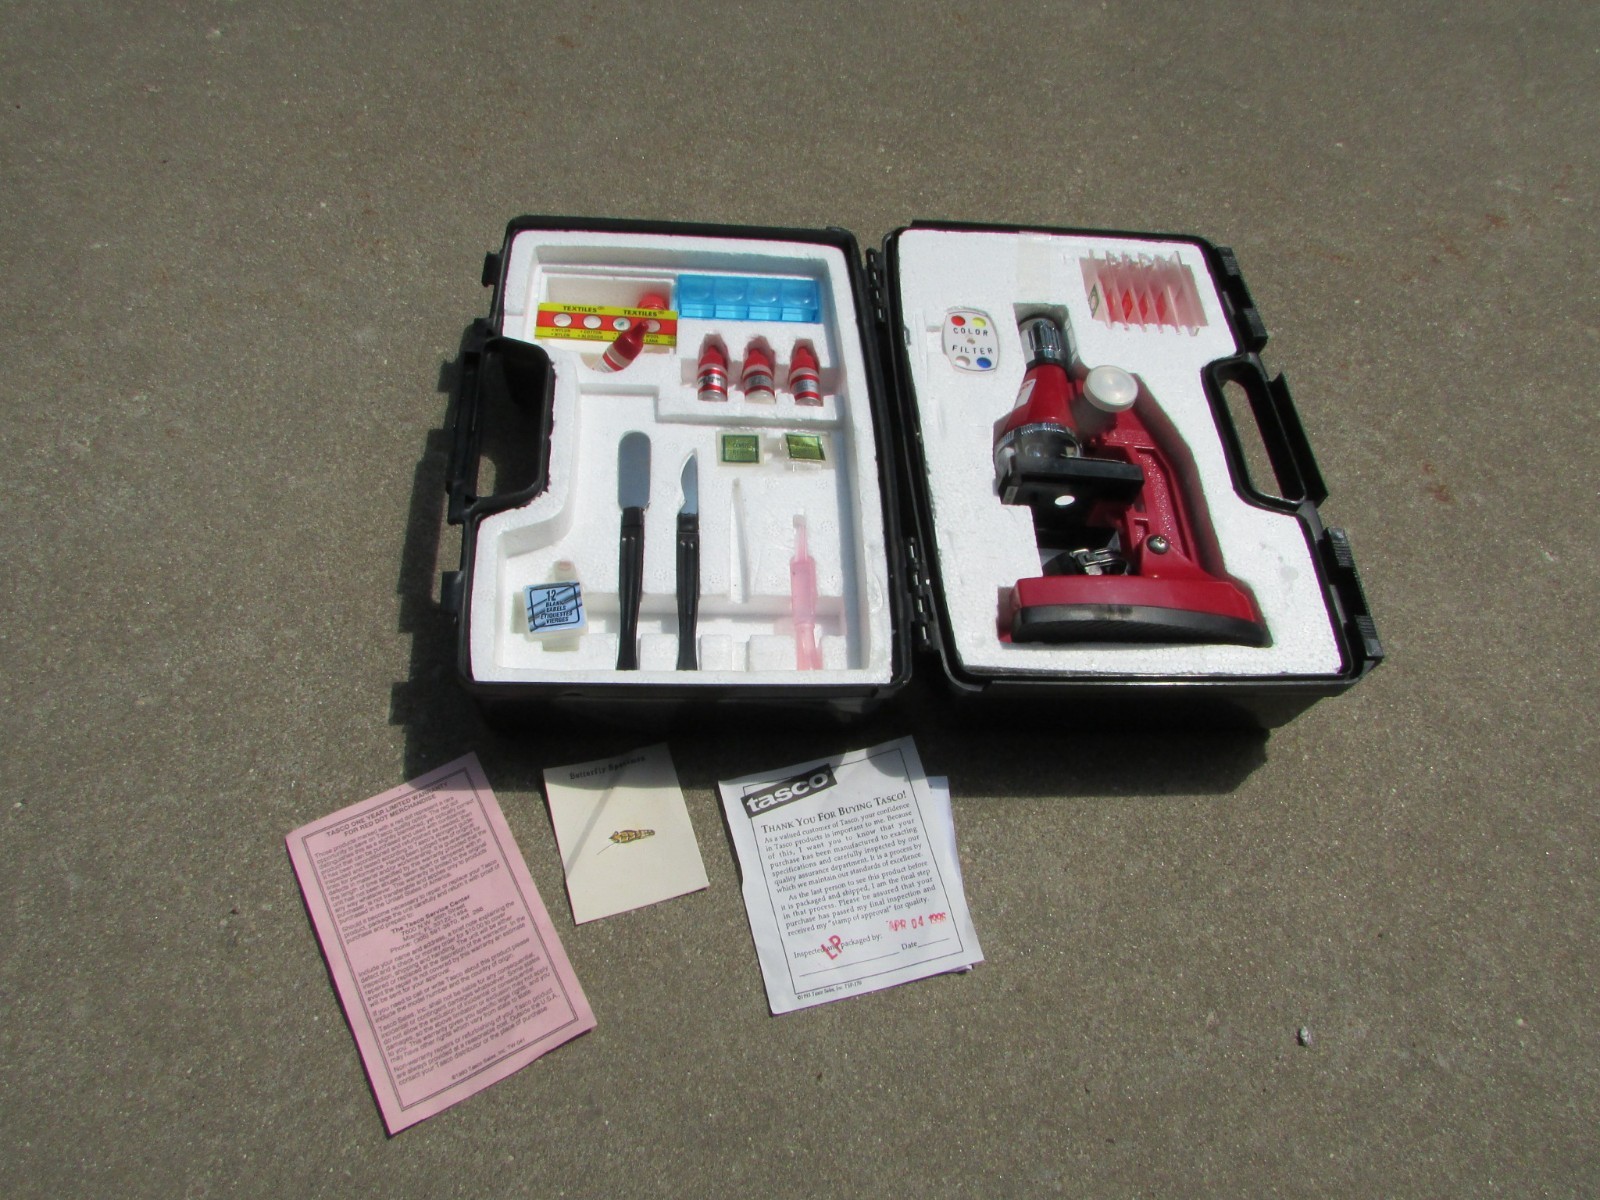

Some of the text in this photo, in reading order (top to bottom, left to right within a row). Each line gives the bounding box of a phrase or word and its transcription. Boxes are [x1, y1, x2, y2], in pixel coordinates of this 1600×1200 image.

[563, 305, 598, 313] TEXTILES
[624, 309, 658, 317] TEXTILES
[952, 327, 988, 337] COLOR
[952, 344, 993, 355] FILTER
[546, 589, 557, 602] 12
[546, 605, 567, 613] LABELS
[746, 773, 829, 813] tasco
[326, 823, 350, 838] TASCO
[350, 817, 366, 828] ONE
[366, 808, 385, 821] YEAR
[343, 826, 359, 837] FOR
[359, 820, 374, 831] RED
[374, 814, 389, 824] DOT
[761, 791, 907, 835] THANK YOU FOR BUYING TASCO!
[774, 840, 793, 851] Tasco
[794, 833, 824, 848] products
[831, 823, 864, 838] important
[886, 810, 913, 822] Because
[779, 830, 801, 841] valued
[802, 823, 831, 835] customer
[840, 815, 860, 827] Tasco,
[860, 813, 877, 822] your
[876, 802, 910, 816] confidence
[770, 855, 801, 870] purchase
[801, 852, 814, 861] has
[815, 848, 832, 857] been
[833, 836, 879, 853] manufactured
[889, 825, 918, 839] exacting
[779, 848, 796, 859] this,
[806, 841, 825, 851] want
[828, 838, 843, 848] you
[856, 828, 876, 838] know
[880, 823, 895, 832] that
[898, 819, 915, 829] your
[772, 860, 818, 879] specifications
[818, 856, 832, 865] and
[833, 849, 864, 863] carefully
[864, 840, 896, 855] inspected
[774, 874, 798, 887] quality
[798, 867, 830, 880] assurance
[830, 856, 870, 873] department.
[889, 846, 914, 858] process
[776, 883, 797, 894] which
[808, 873, 837, 886] maintain
[849, 862, 881, 875] standards
[888, 850, 924, 865] excellence.
[792, 908, 807, 918] that
[808, 902, 837, 916] process.
[838, 895, 861, 906] Please
[872, 885, 900, 898] assured
[900, 881, 915, 890] that
[916, 877, 934, 888] your
[795, 895, 827, 910] packaged
[827, 891, 841, 900] and
[841, 884, 871, 899] shipped,
[888, 876, 899, 885] the
[900, 871, 916, 881] final
[916, 867, 932, 878] step
[798, 890, 810, 899] the
[810, 887, 823, 896] last
[824, 882, 847, 894] person
[867, 872, 880, 881] this
[880, 865, 907, 879] product
[907, 860, 928, 871] before
[390, 894, 471, 935] The Tasco Service Center
[785, 915, 817, 930] purchase
[818, 912, 831, 921] has
[831, 906, 856, 919] passed
[868, 898, 886, 908] final
[886, 888, 922, 905] inspection
[922, 884, 936, 893] and
[787, 924, 816, 937] received
[827, 915, 853, 929] "stamp
[859, 905, 894, 921] approval"
[893, 901, 904, 910] for
[903, 895, 931, 909] quality.
[911, 915, 924, 929] 04
[820, 934, 844, 960] LP
[840, 935, 871, 949] packaged
[900, 940, 918, 951] Date
